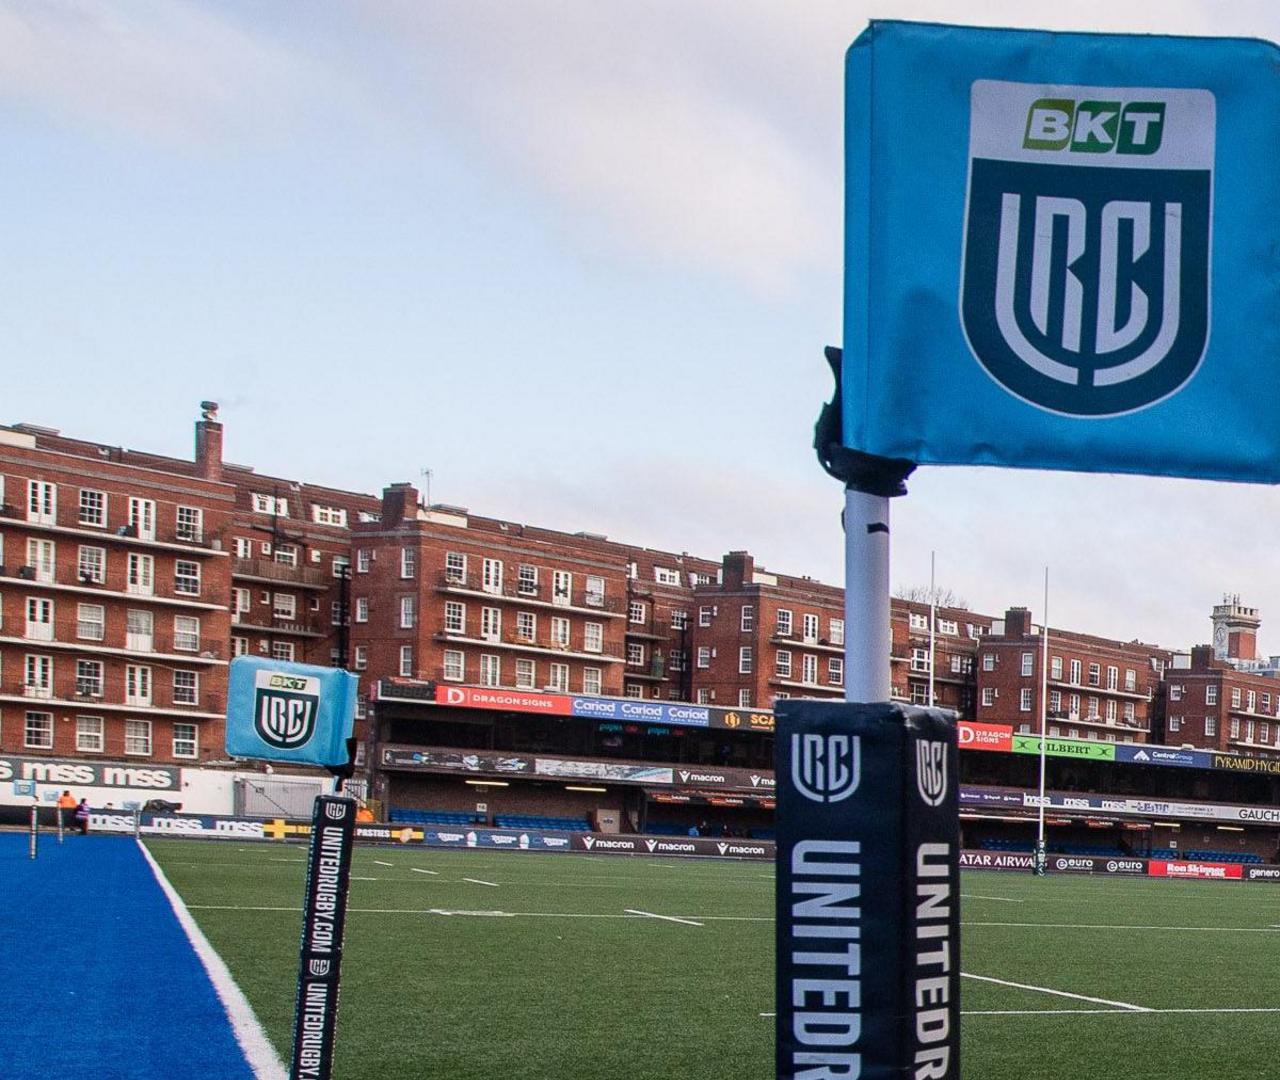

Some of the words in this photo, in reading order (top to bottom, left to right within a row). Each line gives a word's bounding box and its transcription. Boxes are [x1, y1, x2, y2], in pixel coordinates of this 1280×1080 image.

[1023, 100, 1164, 153] BKT
[270, 675, 307, 690] BKT
[473, 694, 521, 705] DRAGON
[522, 698, 553, 708] SIGNS
[574, 700, 616, 712] Cariad
[621, 703, 663, 716] Cariad
[668, 707, 709, 719] Cariad
[975, 730, 1011, 739] DRAGON
[1214, 755, 1255, 770] PYRAMID
[23, 762, 95, 784] mss
[104, 767, 172, 788] mss
[691, 774, 725, 783] macron
[1064, 797, 1090, 807] mss
[152, 816, 204, 832] mss
[357, 828, 390, 838] PASTIES
[596, 840, 634, 849] macron
[658, 843, 695, 852] macron
[729, 846, 765, 854] macron
[959, 854, 992, 866] ATAR
[1068, 858, 1094, 867] euro
[1118, 861, 1143, 869] euro
[1250, 869, 1280, 878] genero
[311, 827, 344, 953] UNITEDRUGBY.COM
